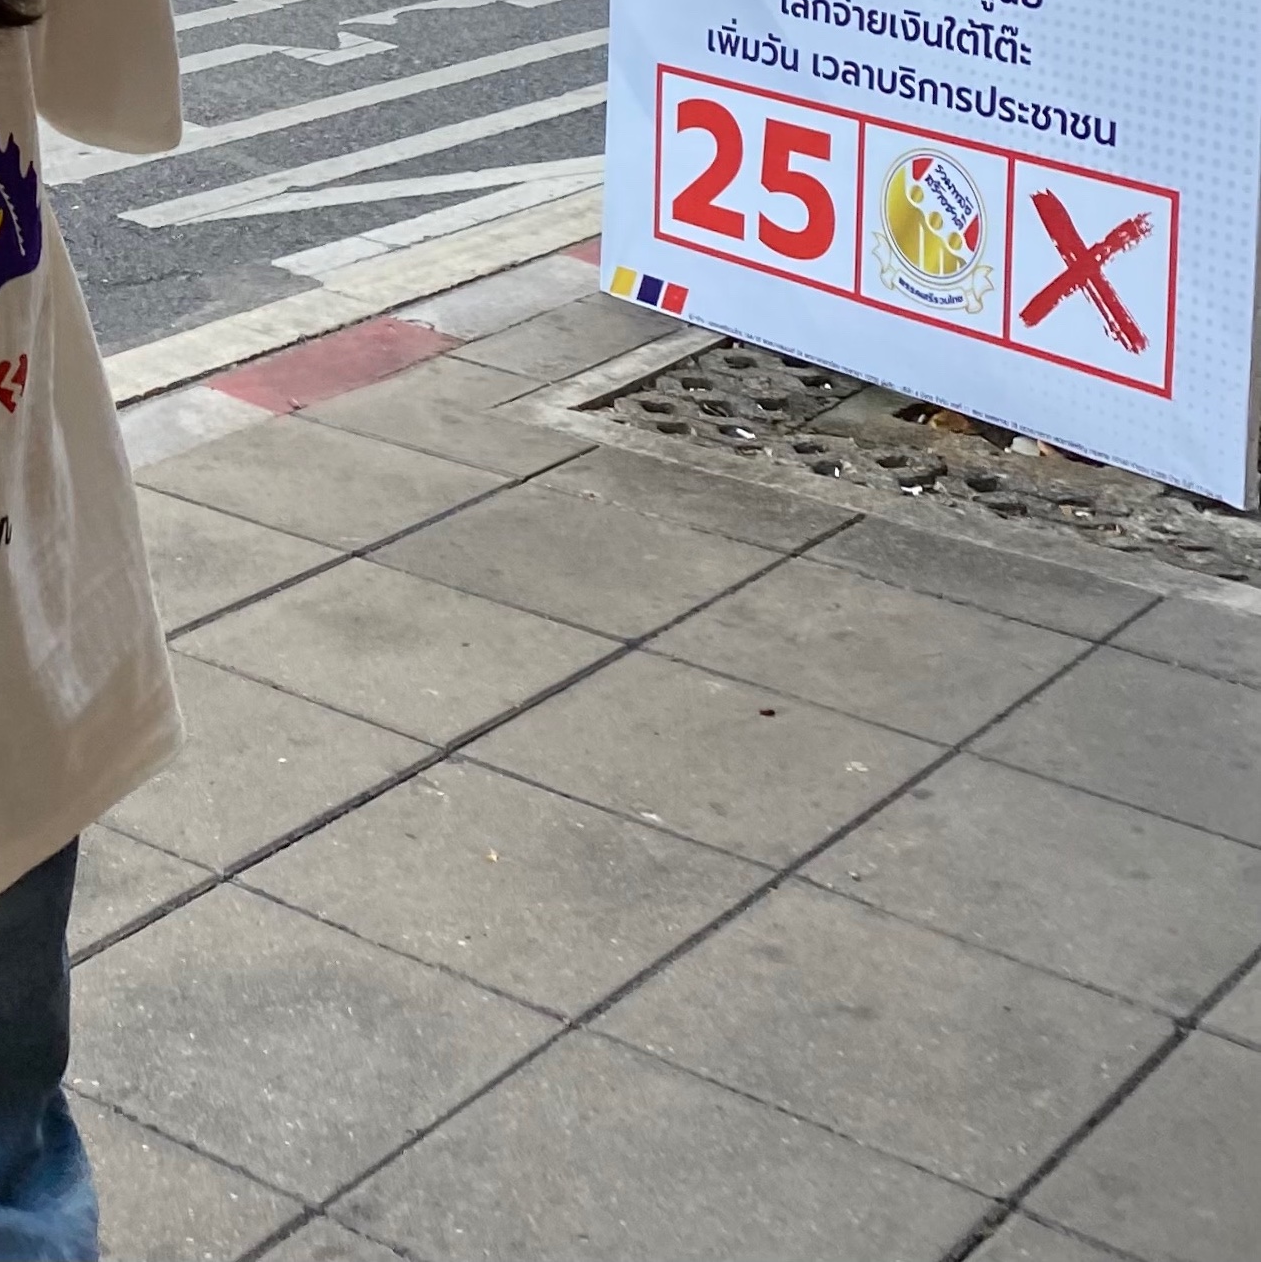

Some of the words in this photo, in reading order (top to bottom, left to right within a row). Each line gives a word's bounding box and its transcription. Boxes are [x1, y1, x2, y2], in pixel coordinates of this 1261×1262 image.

[707, 19, 800, 73] เพิ่มวัน
[812, 51, 1117, 147] เวลาบริการประชาชน
[672, 97, 836, 262] 25
